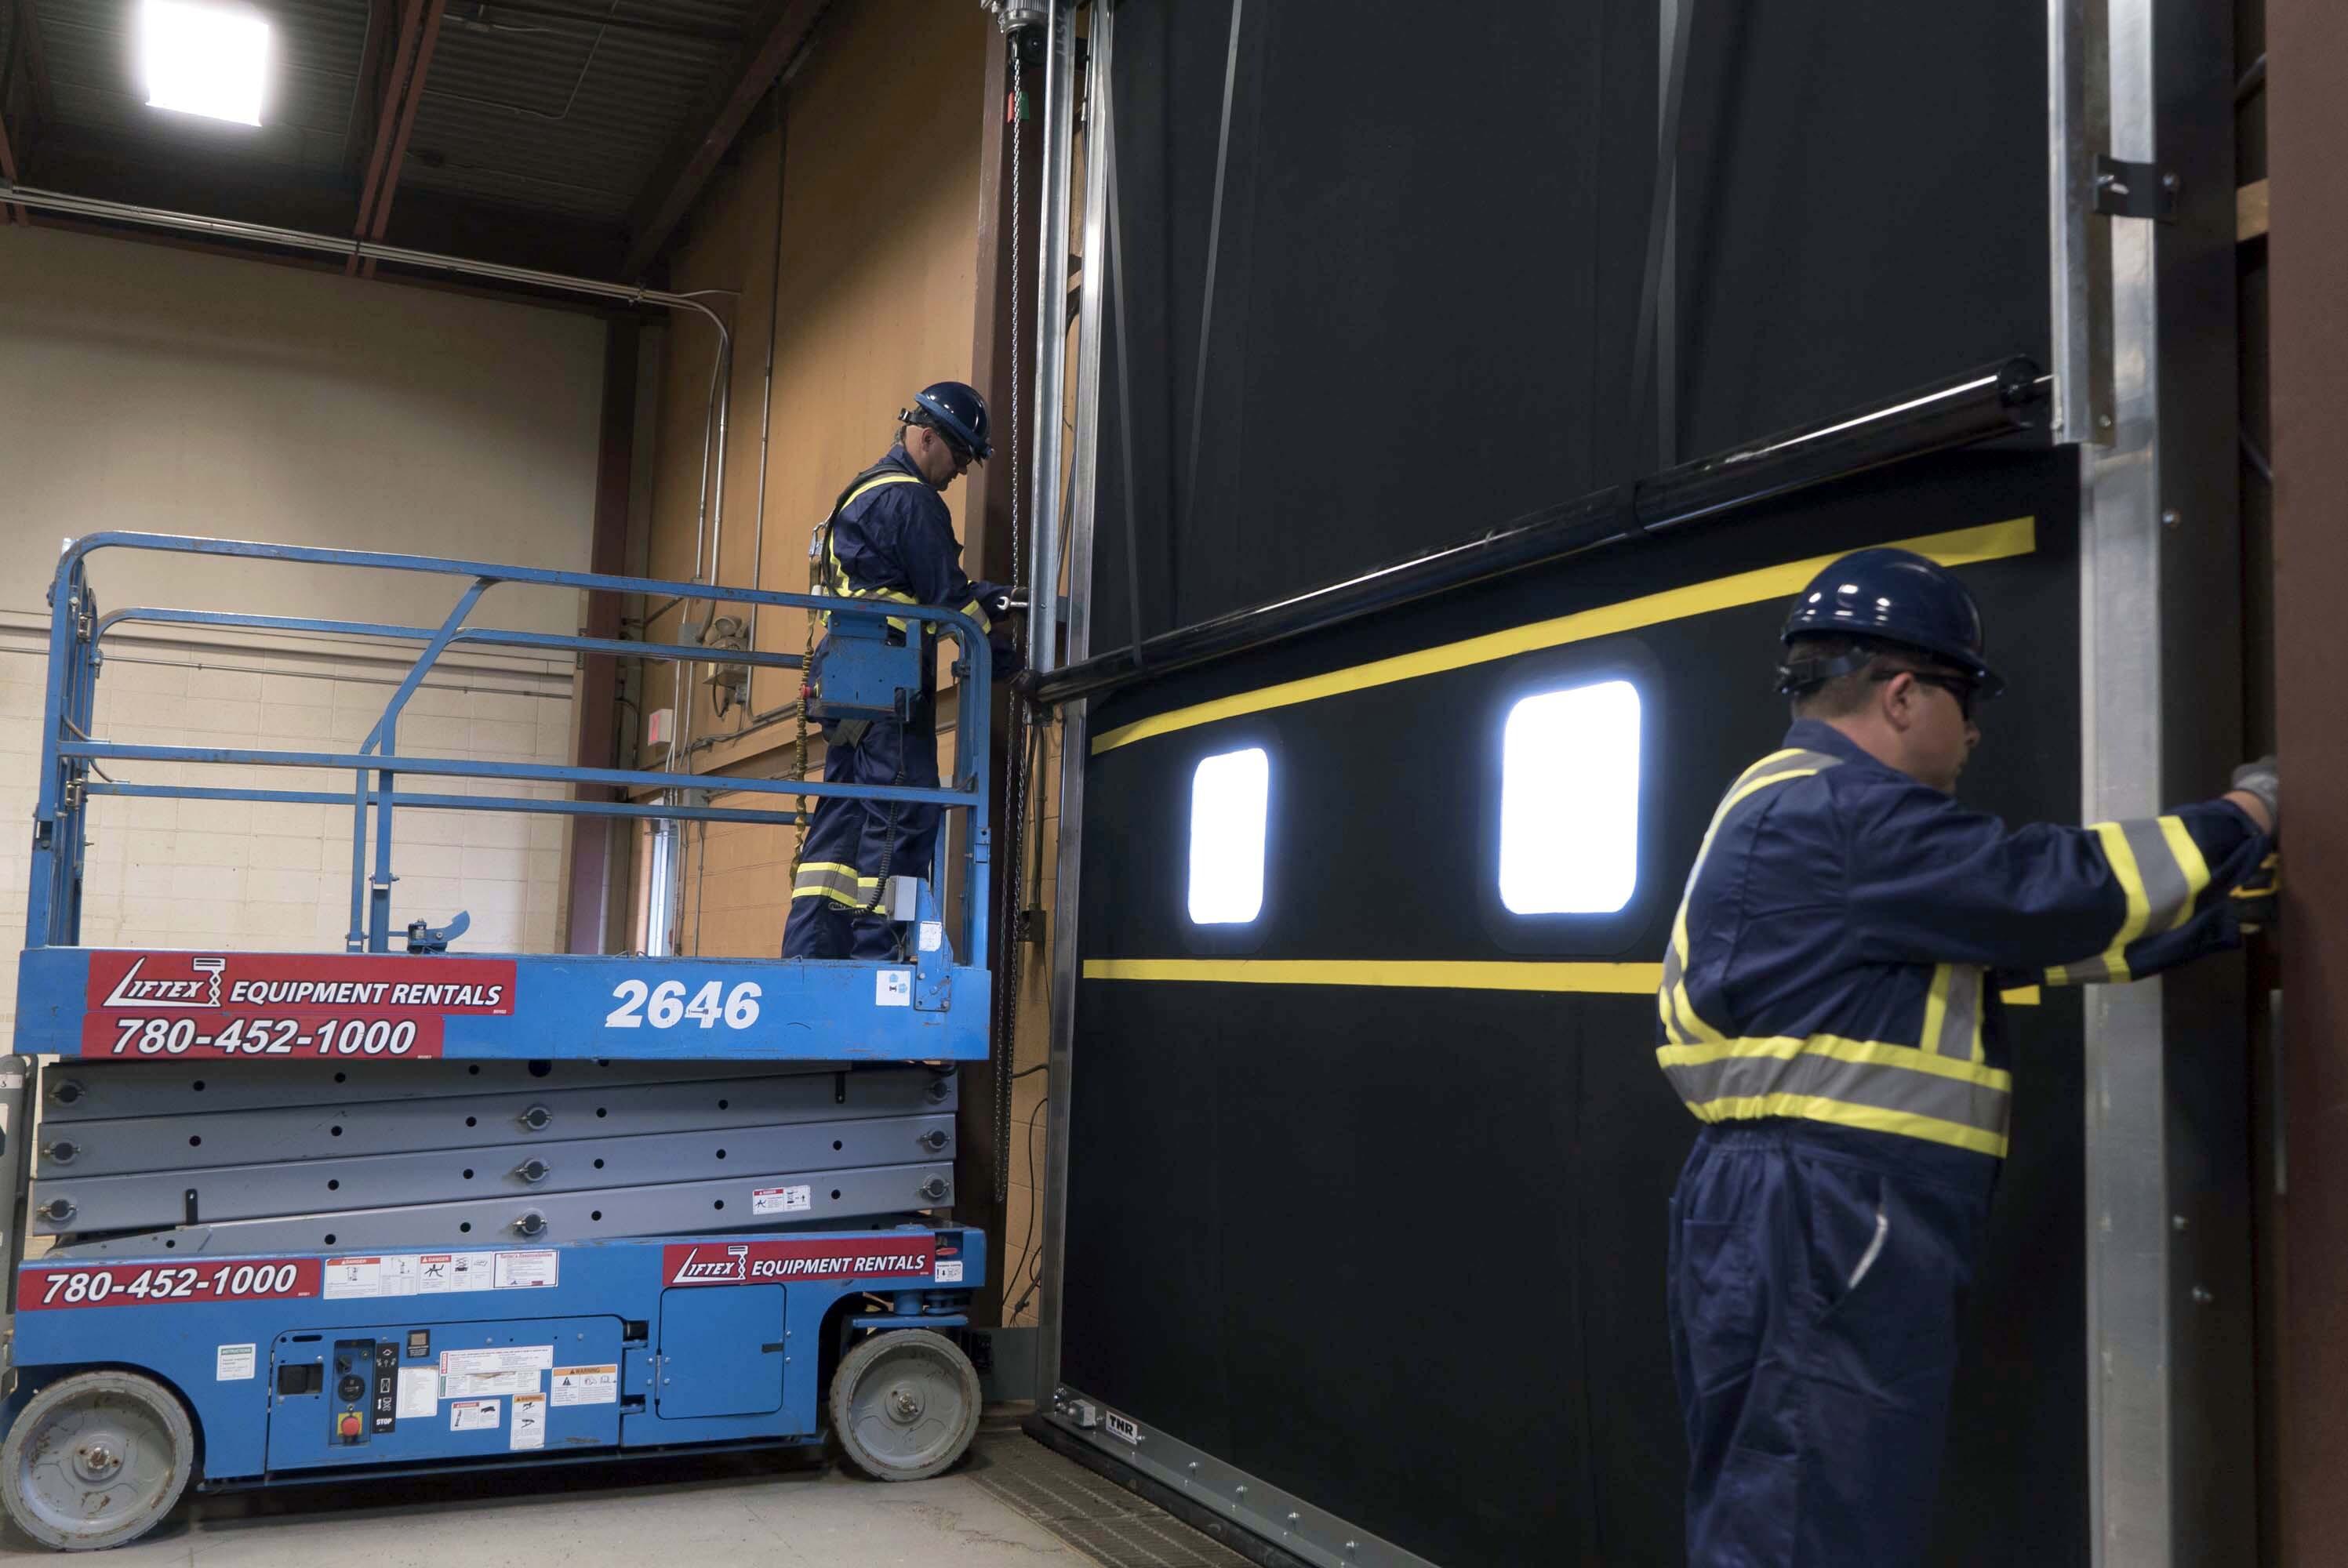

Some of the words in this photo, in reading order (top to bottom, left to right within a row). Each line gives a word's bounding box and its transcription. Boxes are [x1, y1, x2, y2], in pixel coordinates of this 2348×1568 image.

[103, 956, 220, 1007] LIFTEX
[230, 981, 389, 1006] EQUIPMENT
[391, 983, 503, 1006] RENTALS
[604, 979, 762, 1029] 2646
[111, 1018, 416, 1054] 780-452-1000
[673, 1247, 745, 1283] LIFTEX
[751, 1257, 852, 1276] EQUIPMENT
[854, 1254, 925, 1272] RENTALS
[42, 1264, 298, 1305] 780-452-1000
[1110, 1414, 1133, 1436] TNR
